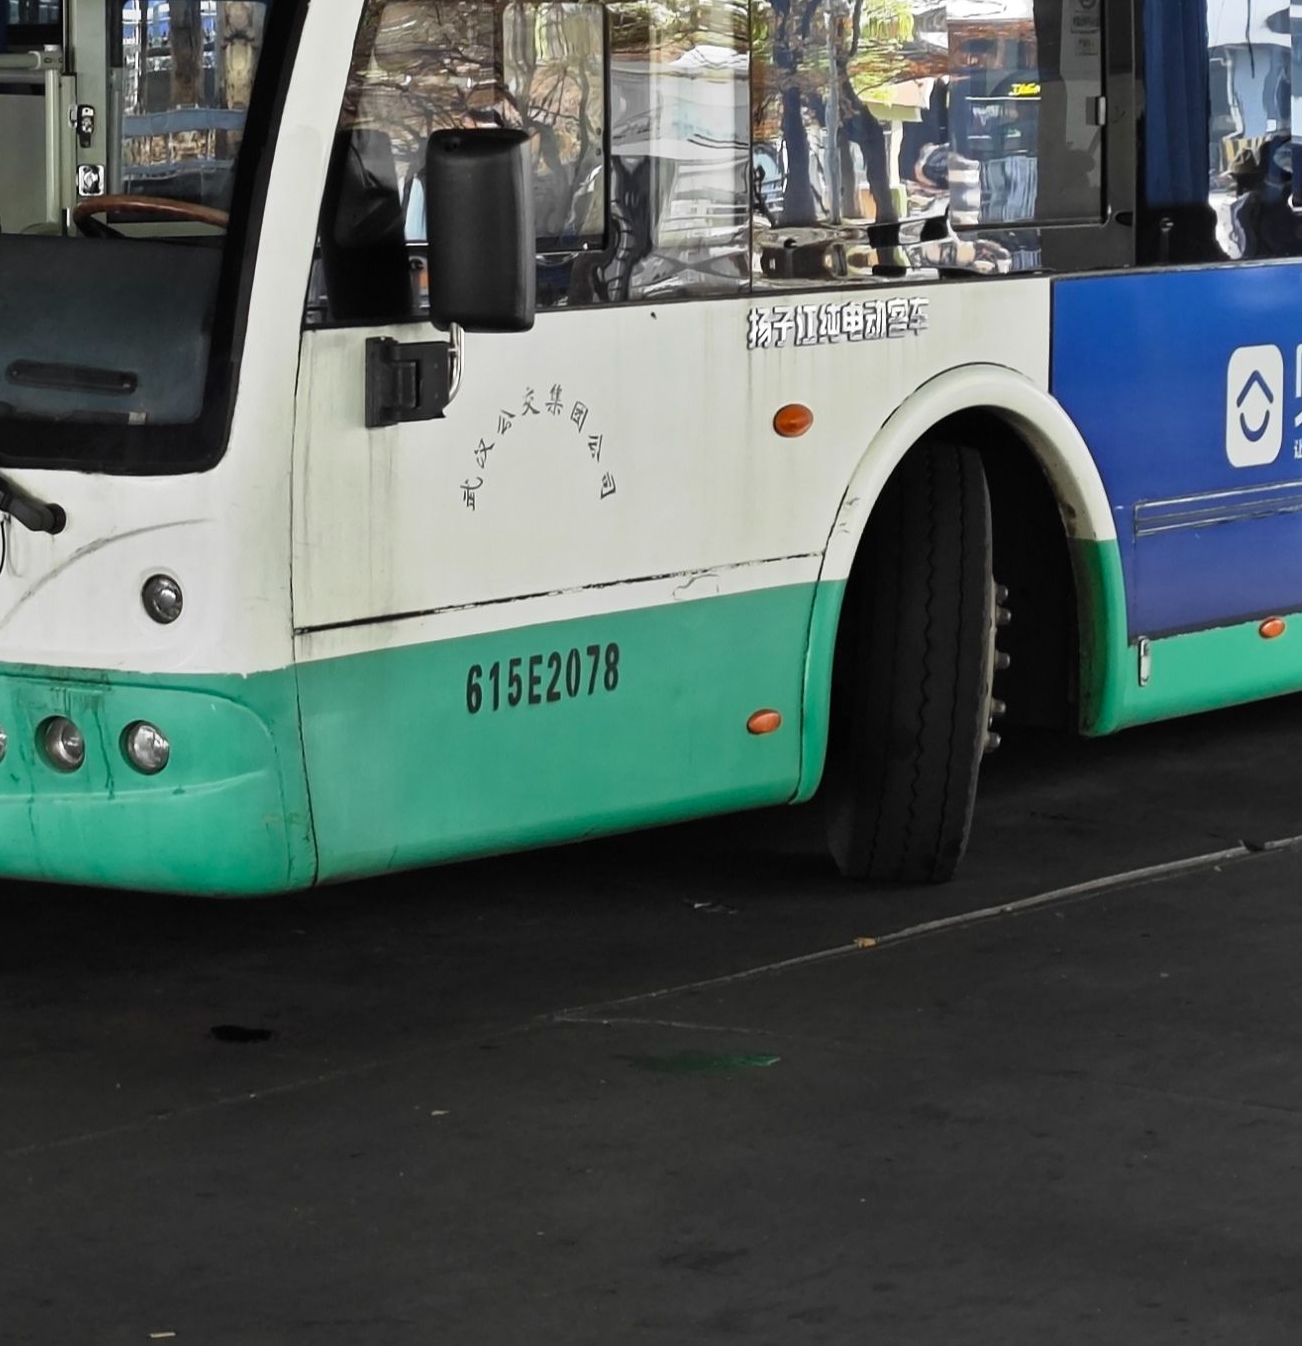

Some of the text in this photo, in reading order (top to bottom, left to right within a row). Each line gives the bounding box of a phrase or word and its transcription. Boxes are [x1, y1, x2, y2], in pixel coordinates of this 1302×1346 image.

[748, 297, 930, 349] 扬子江纯电动客车
[466, 642, 620, 714] 615E2078
